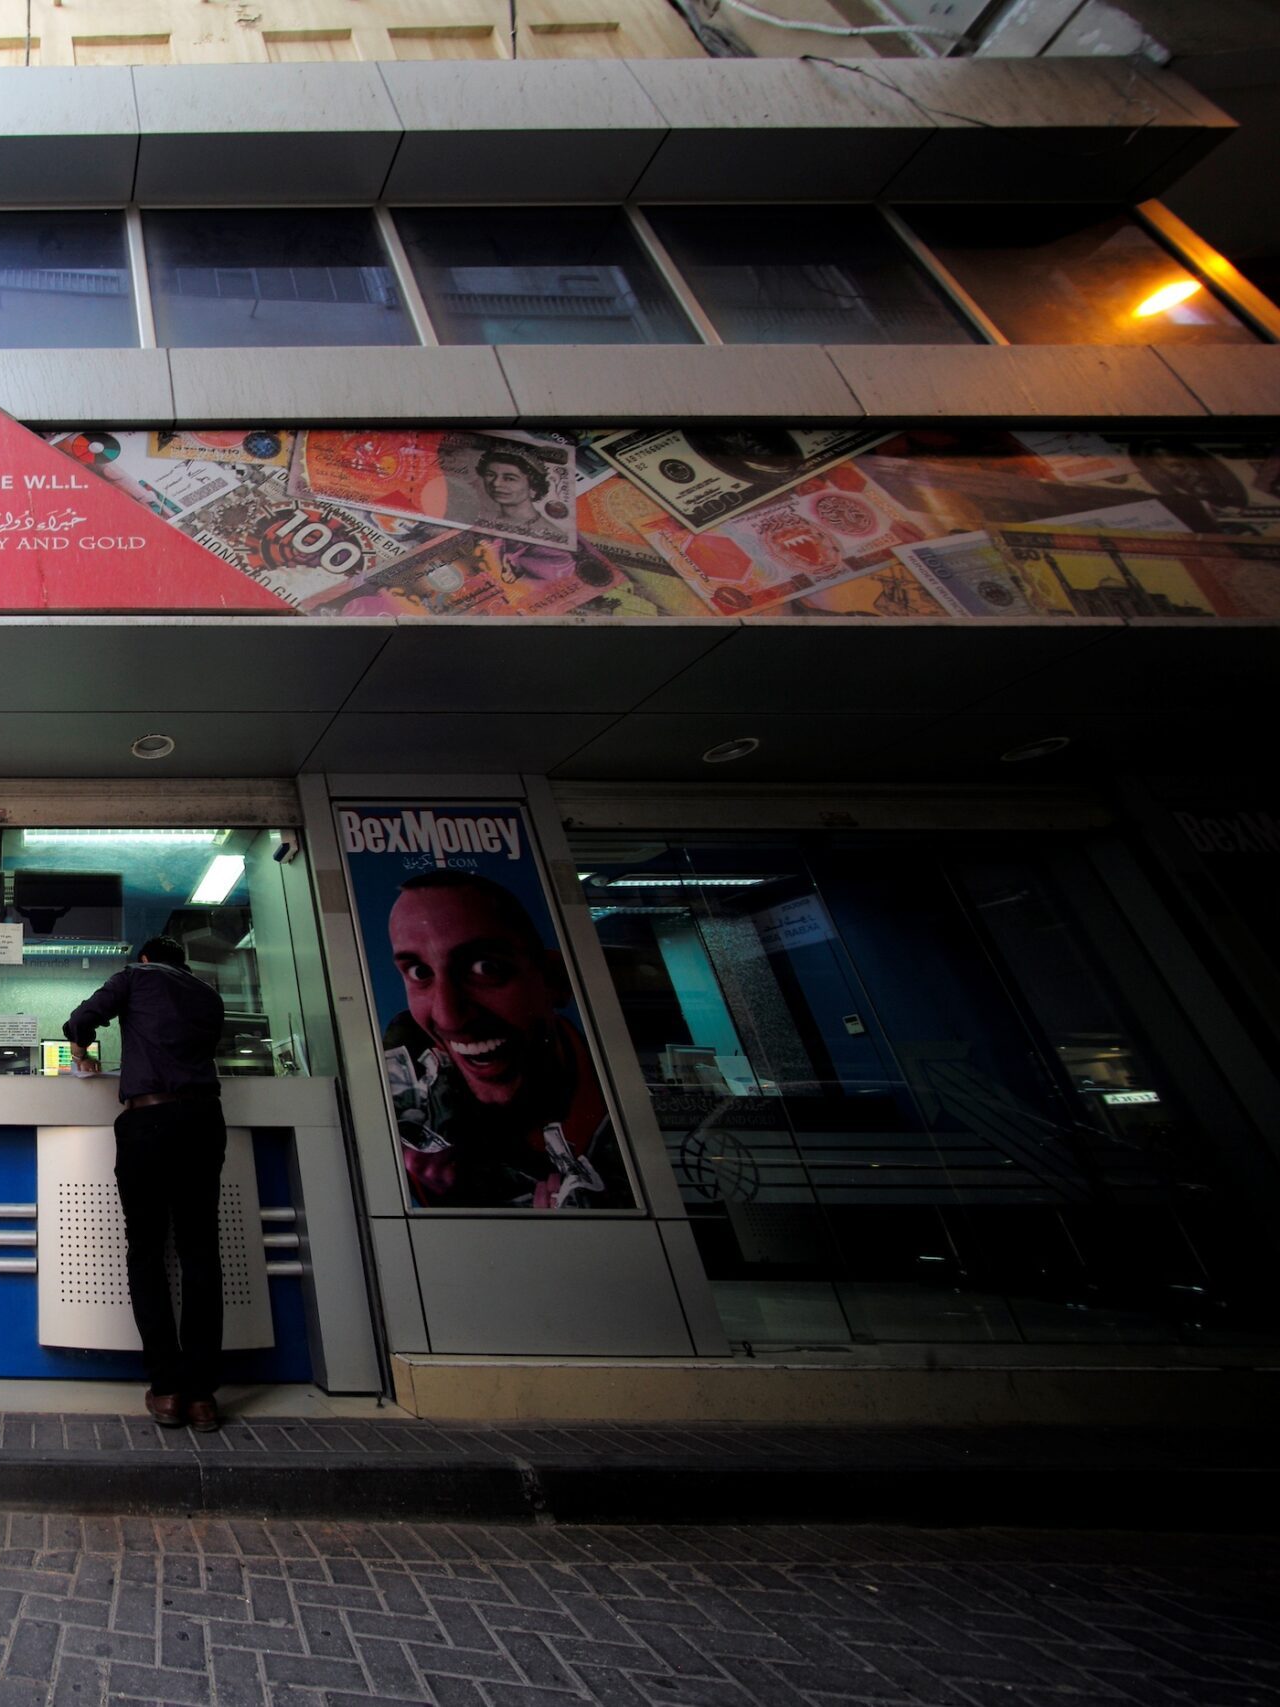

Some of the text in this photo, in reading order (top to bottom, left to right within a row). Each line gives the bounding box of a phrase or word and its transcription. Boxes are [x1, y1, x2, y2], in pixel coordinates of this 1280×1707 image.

[23, 475, 89, 490] W.L.L.
[16, 537, 70, 550] AND
[78, 535, 147, 550] GOLD
[275, 508, 363, 575] 100
[338, 809, 522, 868] BexMoney
